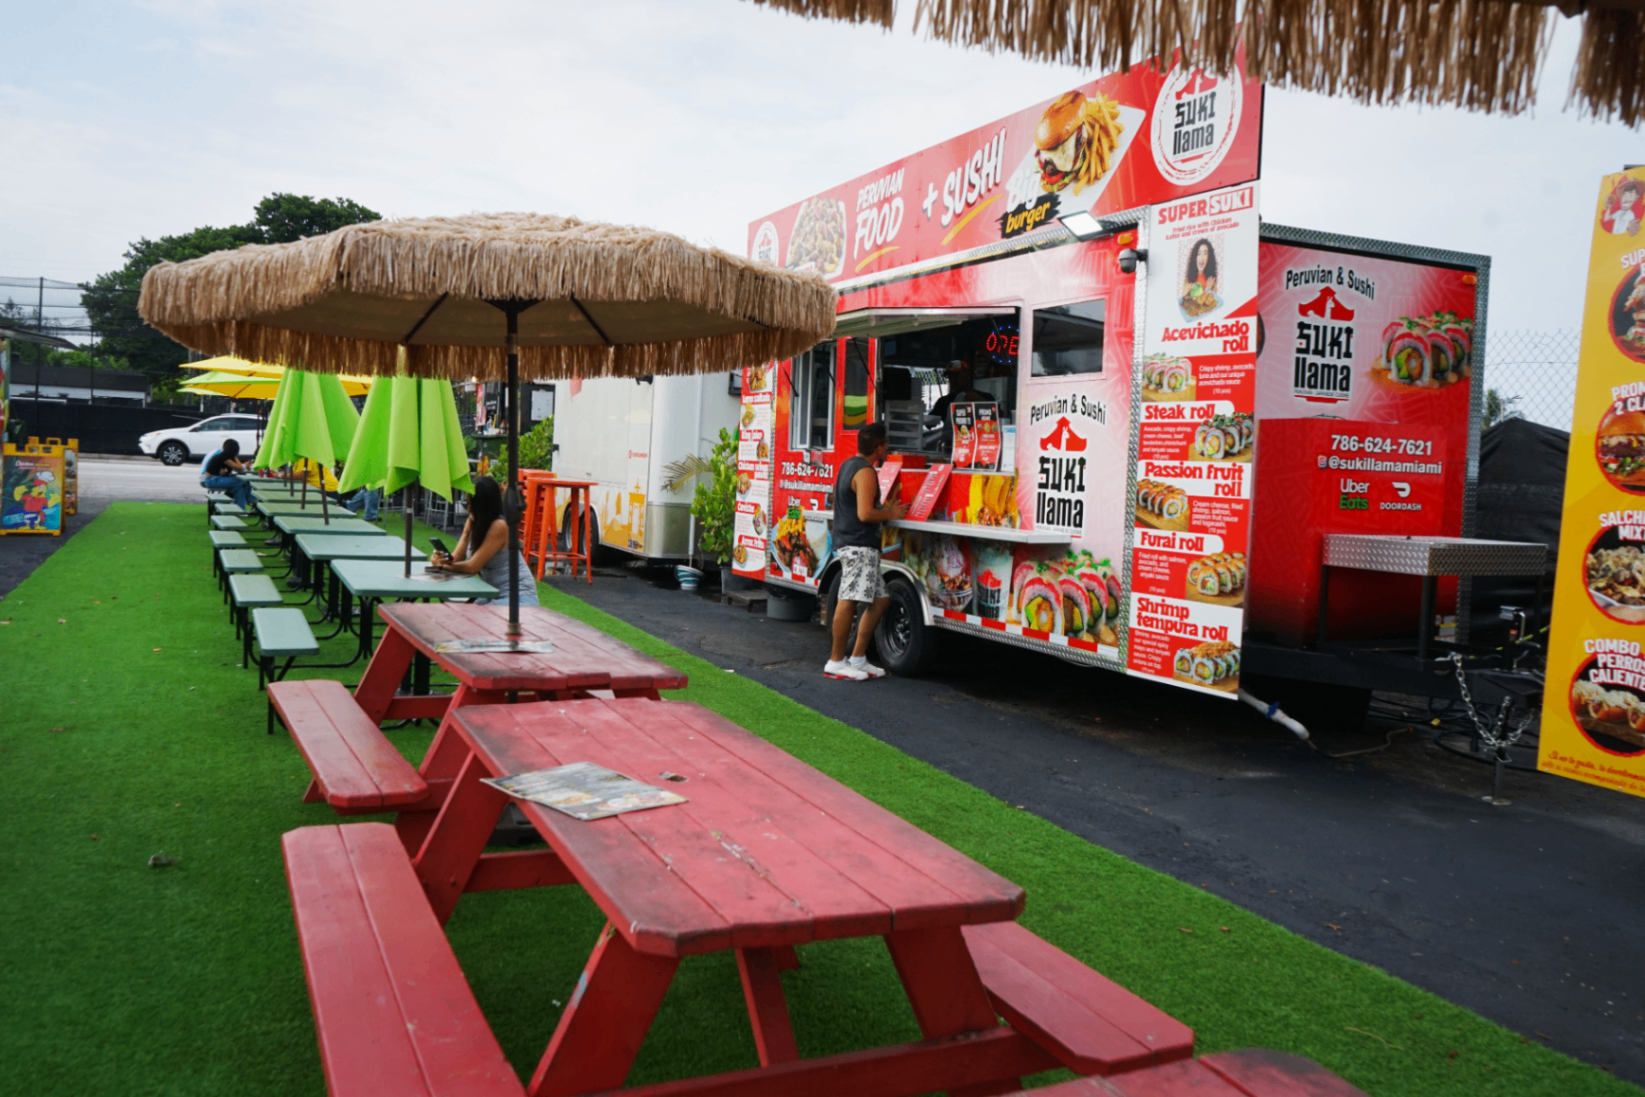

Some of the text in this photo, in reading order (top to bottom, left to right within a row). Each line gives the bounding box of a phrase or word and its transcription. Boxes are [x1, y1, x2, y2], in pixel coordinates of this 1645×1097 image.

[1174, 91, 1216, 129] SUKI
[1173, 123, 1214, 156] llama
[941, 128, 1005, 227] SUSHI
[857, 168, 905, 212] PERUVIAN
[1006, 167, 1041, 213] Big
[1005, 201, 1050, 233] burger
[1158, 187, 1253, 225] SUPER SUKI
[853, 197, 904, 261] FOOD
[1173, 226, 1185, 234] Fried
[1197, 221, 1209, 229] with
[1211, 217, 1232, 226] Chicken
[1216, 222, 1240, 231] avocado
[1620, 249, 1645, 269] SUP
[1286, 264, 1375, 300] Peruvian & Sushi
[1161, 320, 1249, 342] Acevichado
[1296, 321, 1354, 359] SUKI
[986, 334, 1020, 356] OPE
[1222, 336, 1249, 353] roll
[1294, 356, 1351, 392] llama
[1030, 394, 1106, 426] Peruvian & Sushi
[1145, 404, 1215, 420] Steak roll
[1614, 401, 1624, 415] 2
[1331, 434, 1432, 456] 786-624-7621
[781, 462, 834, 478] 786-624-7621
[1038, 456, 1086, 493] SUKI
[1144, 461, 1244, 481] Passion fruit
[1328, 455, 1442, 474] @sukillamamiami
[784, 479, 834, 493] @sukillamamiami
[1214, 481, 1242, 497] roll
[1340, 478, 1370, 494] Uber
[788, 496, 801, 508] Uber
[1036, 492, 1084, 529] llama
[1193, 500, 1210, 508] Cream
[1339, 495, 1369, 510] Eats
[1380, 502, 1422, 511] DOORDASH
[787, 508, 801, 520] Eats
[1141, 531, 1205, 552] Furai roll
[1137, 597, 1190, 621] Shrimp
[1136, 612, 1229, 642] tempura roll
[1584, 638, 1641, 657] COMBO
[1589, 669, 1645, 691] CALIENTE
